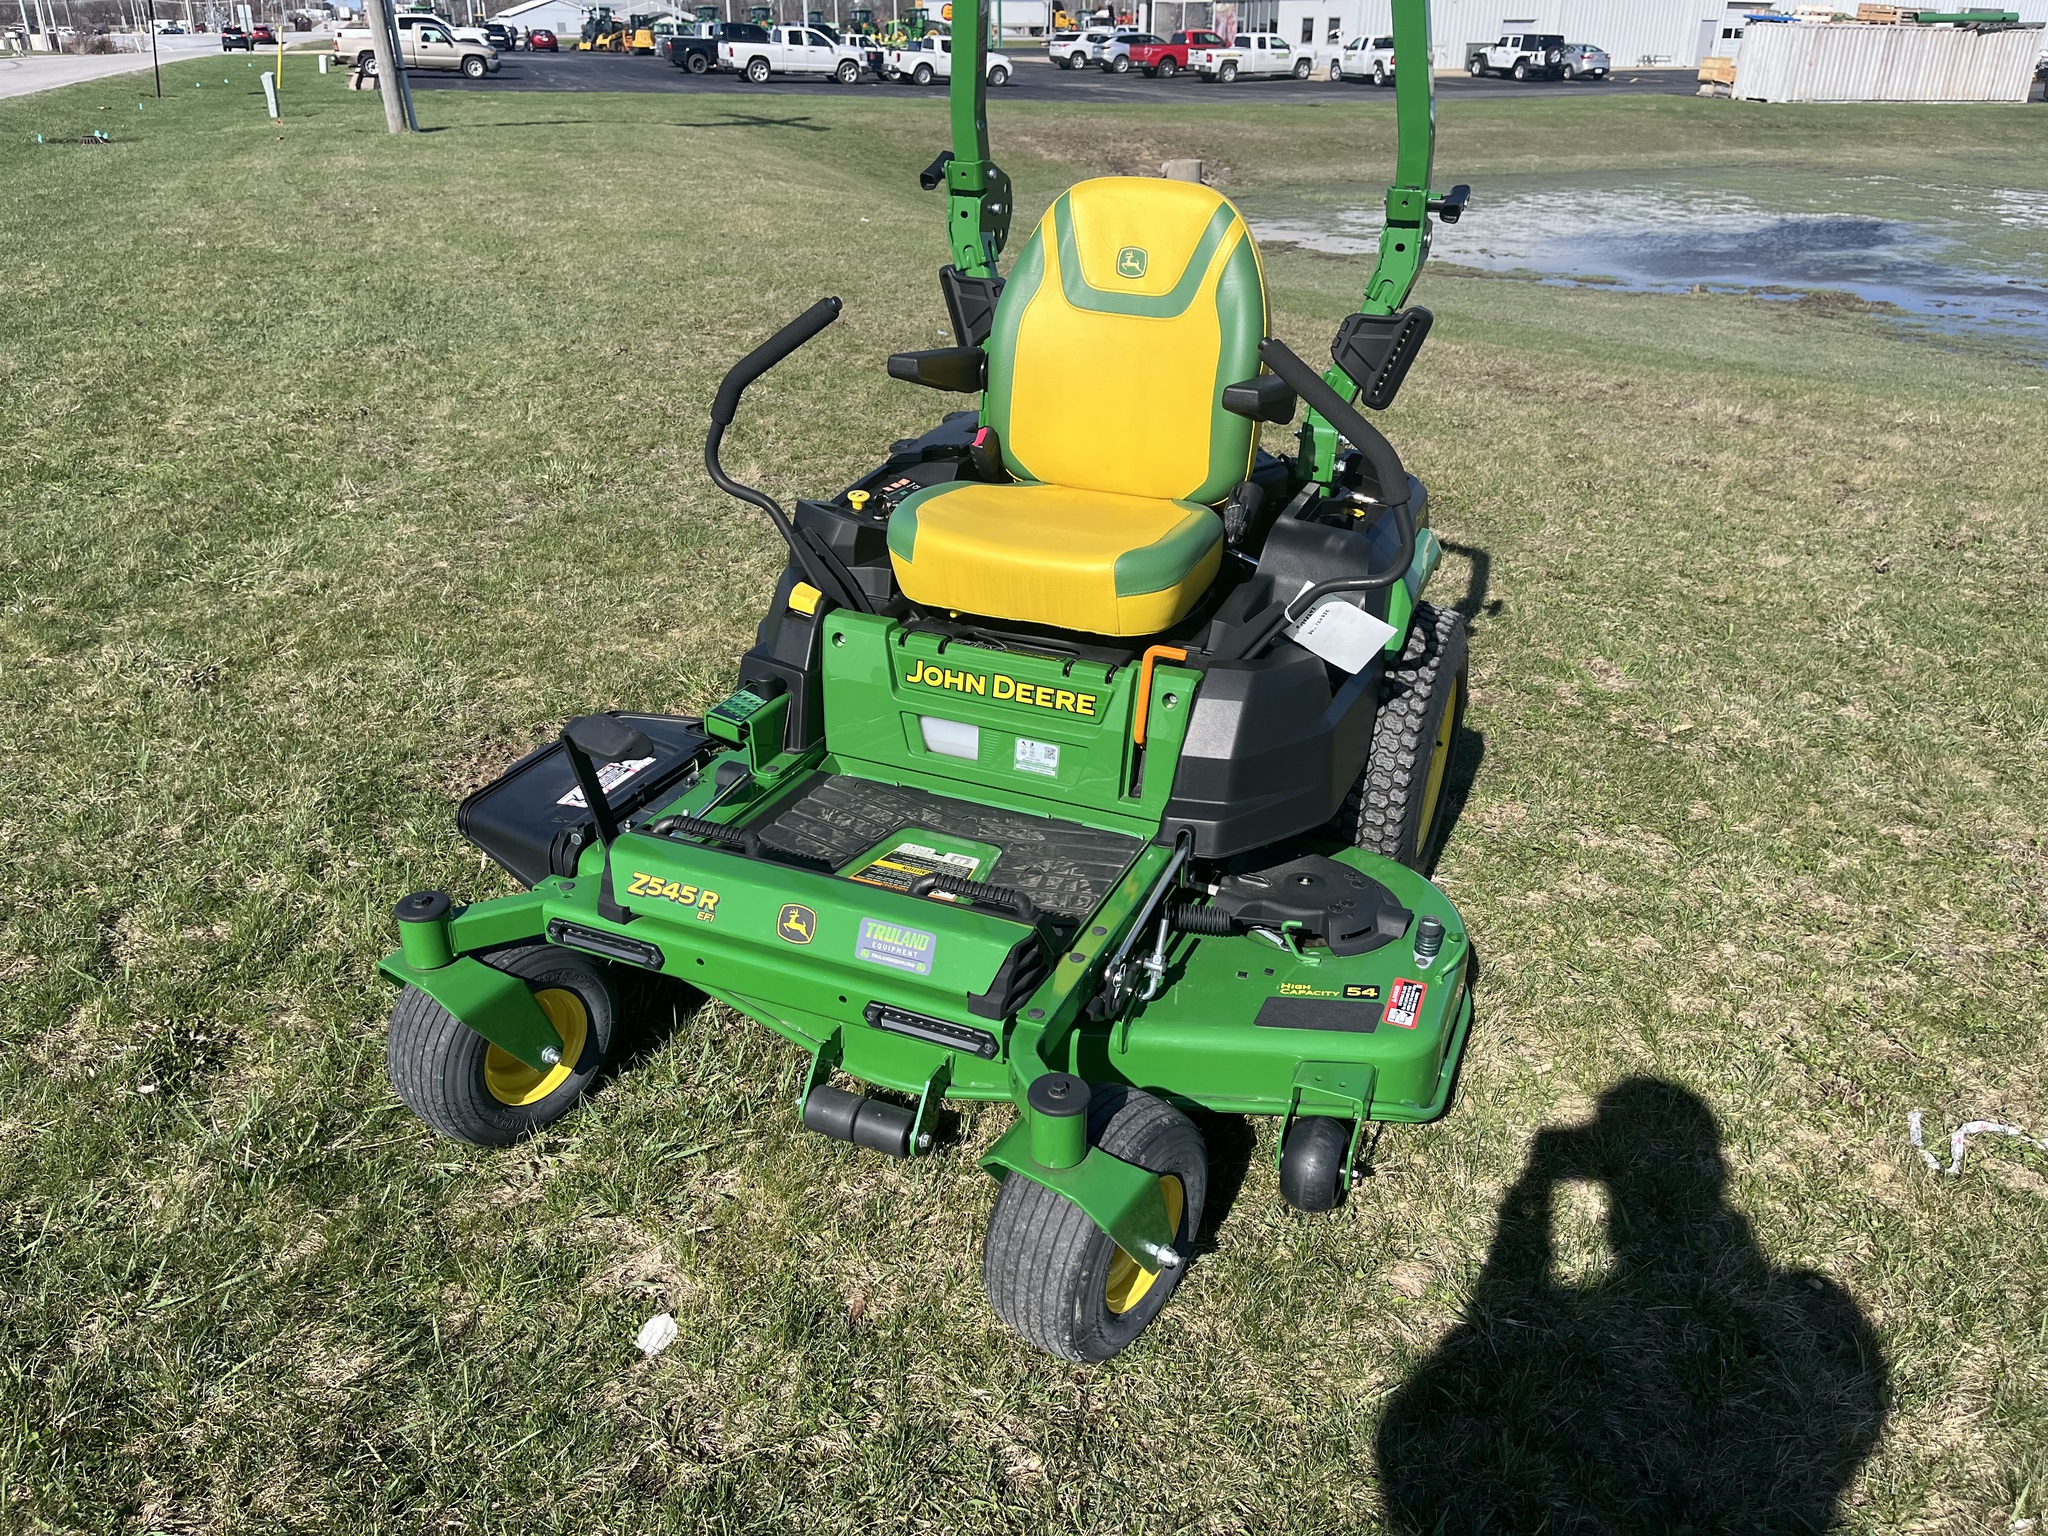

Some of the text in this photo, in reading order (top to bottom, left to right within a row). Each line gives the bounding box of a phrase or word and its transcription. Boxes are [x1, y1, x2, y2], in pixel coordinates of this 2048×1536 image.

[906, 659, 1096, 716] JOHN DEERE
[627, 871, 720, 913] Z545 R
[696, 910, 715, 923] EFI
[865, 921, 930, 952] TRULAND
[871, 941, 918, 958] EQUIPMENT
[1279, 988, 1340, 997] CAPACITY
[1346, 986, 1378, 998] 54
[1280, 982, 1312, 990] HIGH
